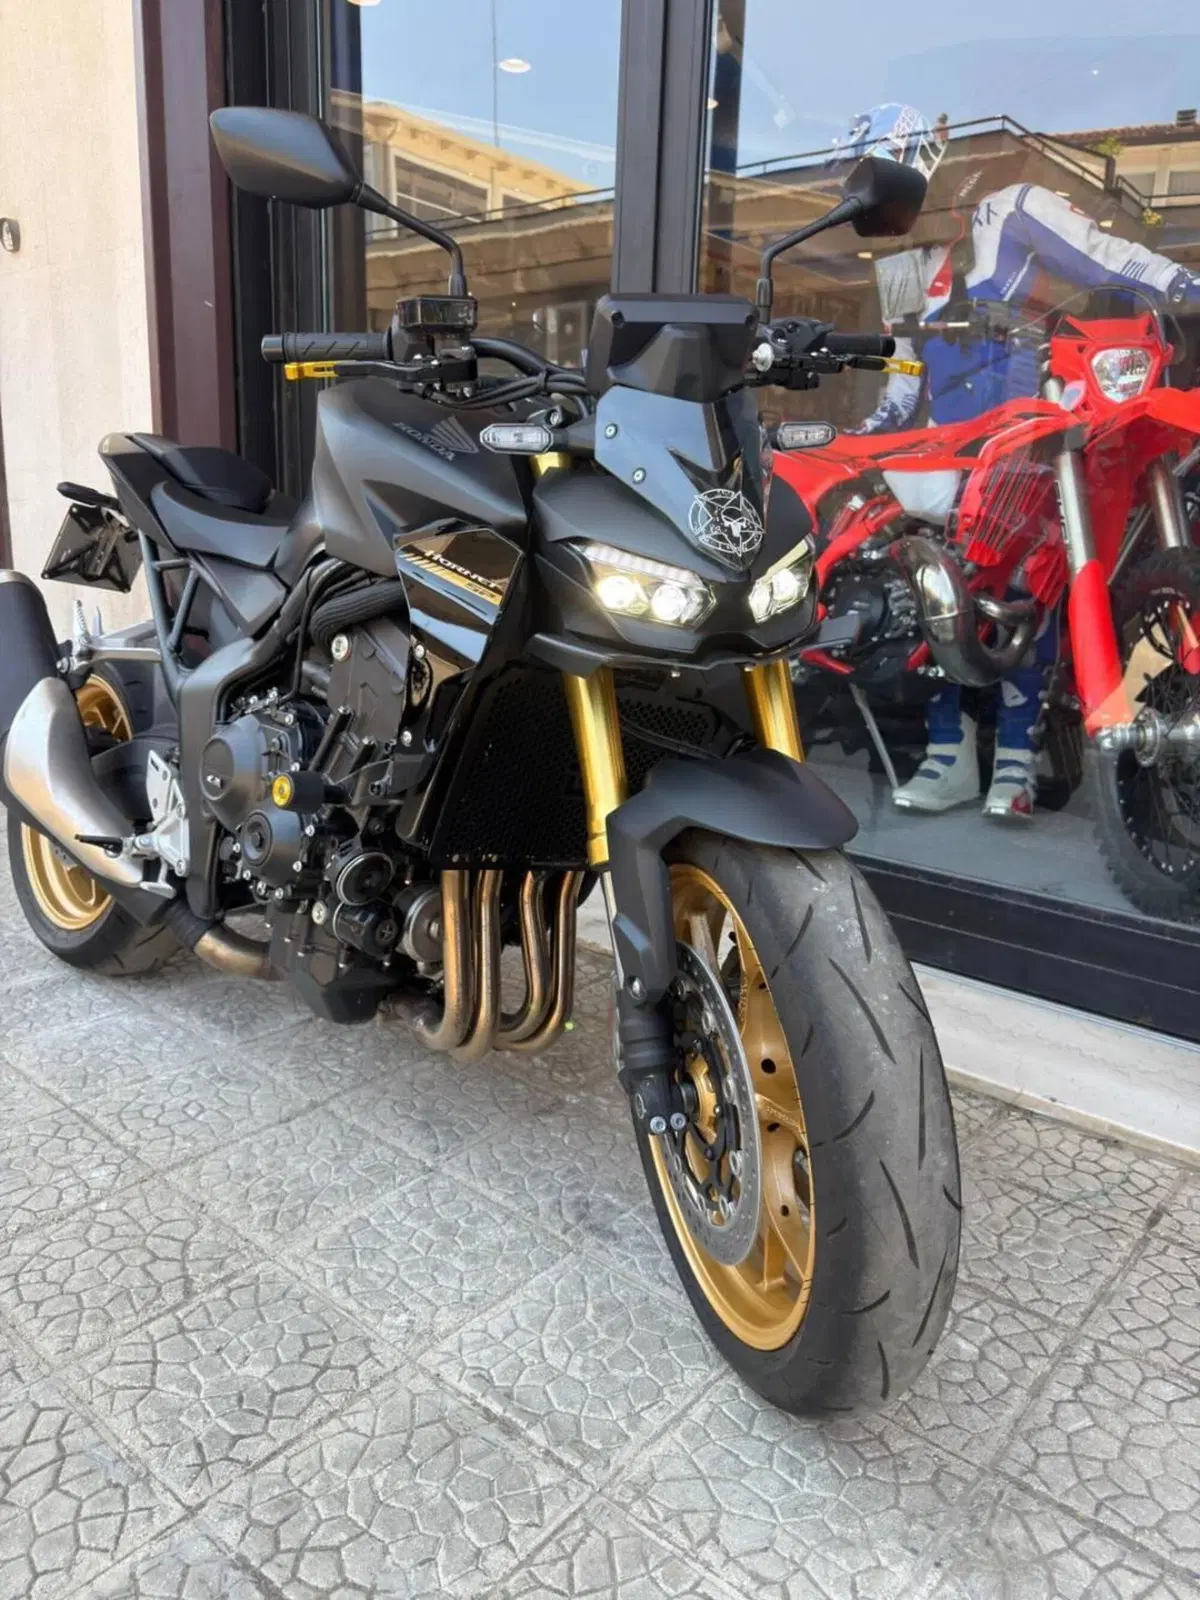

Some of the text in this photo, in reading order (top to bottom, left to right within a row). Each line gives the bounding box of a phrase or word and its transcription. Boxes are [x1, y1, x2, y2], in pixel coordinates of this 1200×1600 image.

[392, 421, 456, 461] HONDA
[424, 550, 497, 588] HORNET
[465, 582, 498, 599] SP
